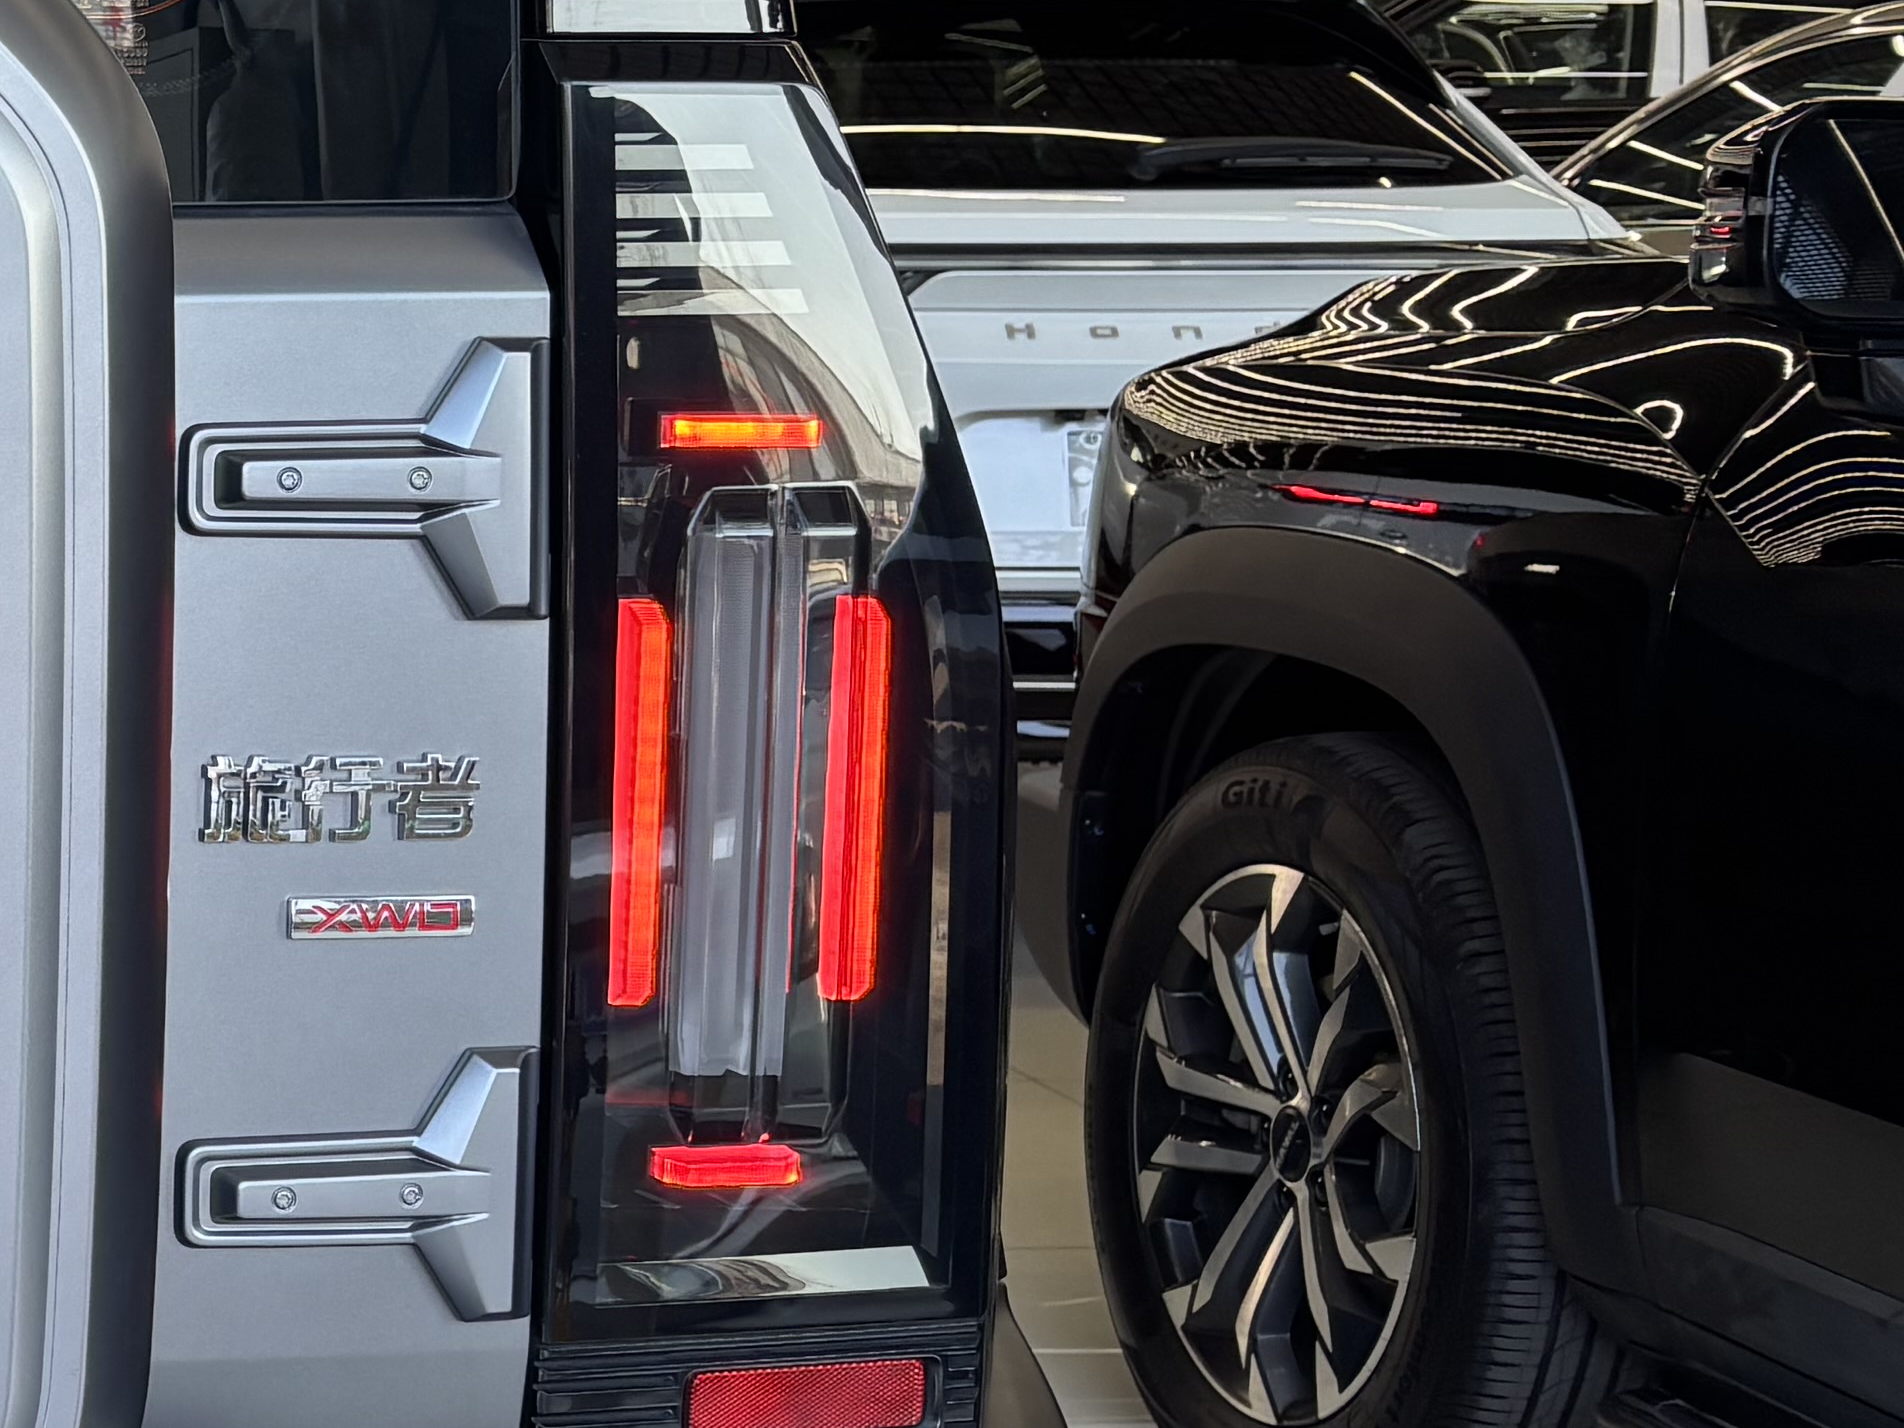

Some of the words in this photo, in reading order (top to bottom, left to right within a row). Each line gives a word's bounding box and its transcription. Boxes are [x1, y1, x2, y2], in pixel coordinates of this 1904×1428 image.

[198, 752, 481, 843] 旅行者
[1221, 778, 1288, 809] Giti
[308, 902, 461, 933] XWD
